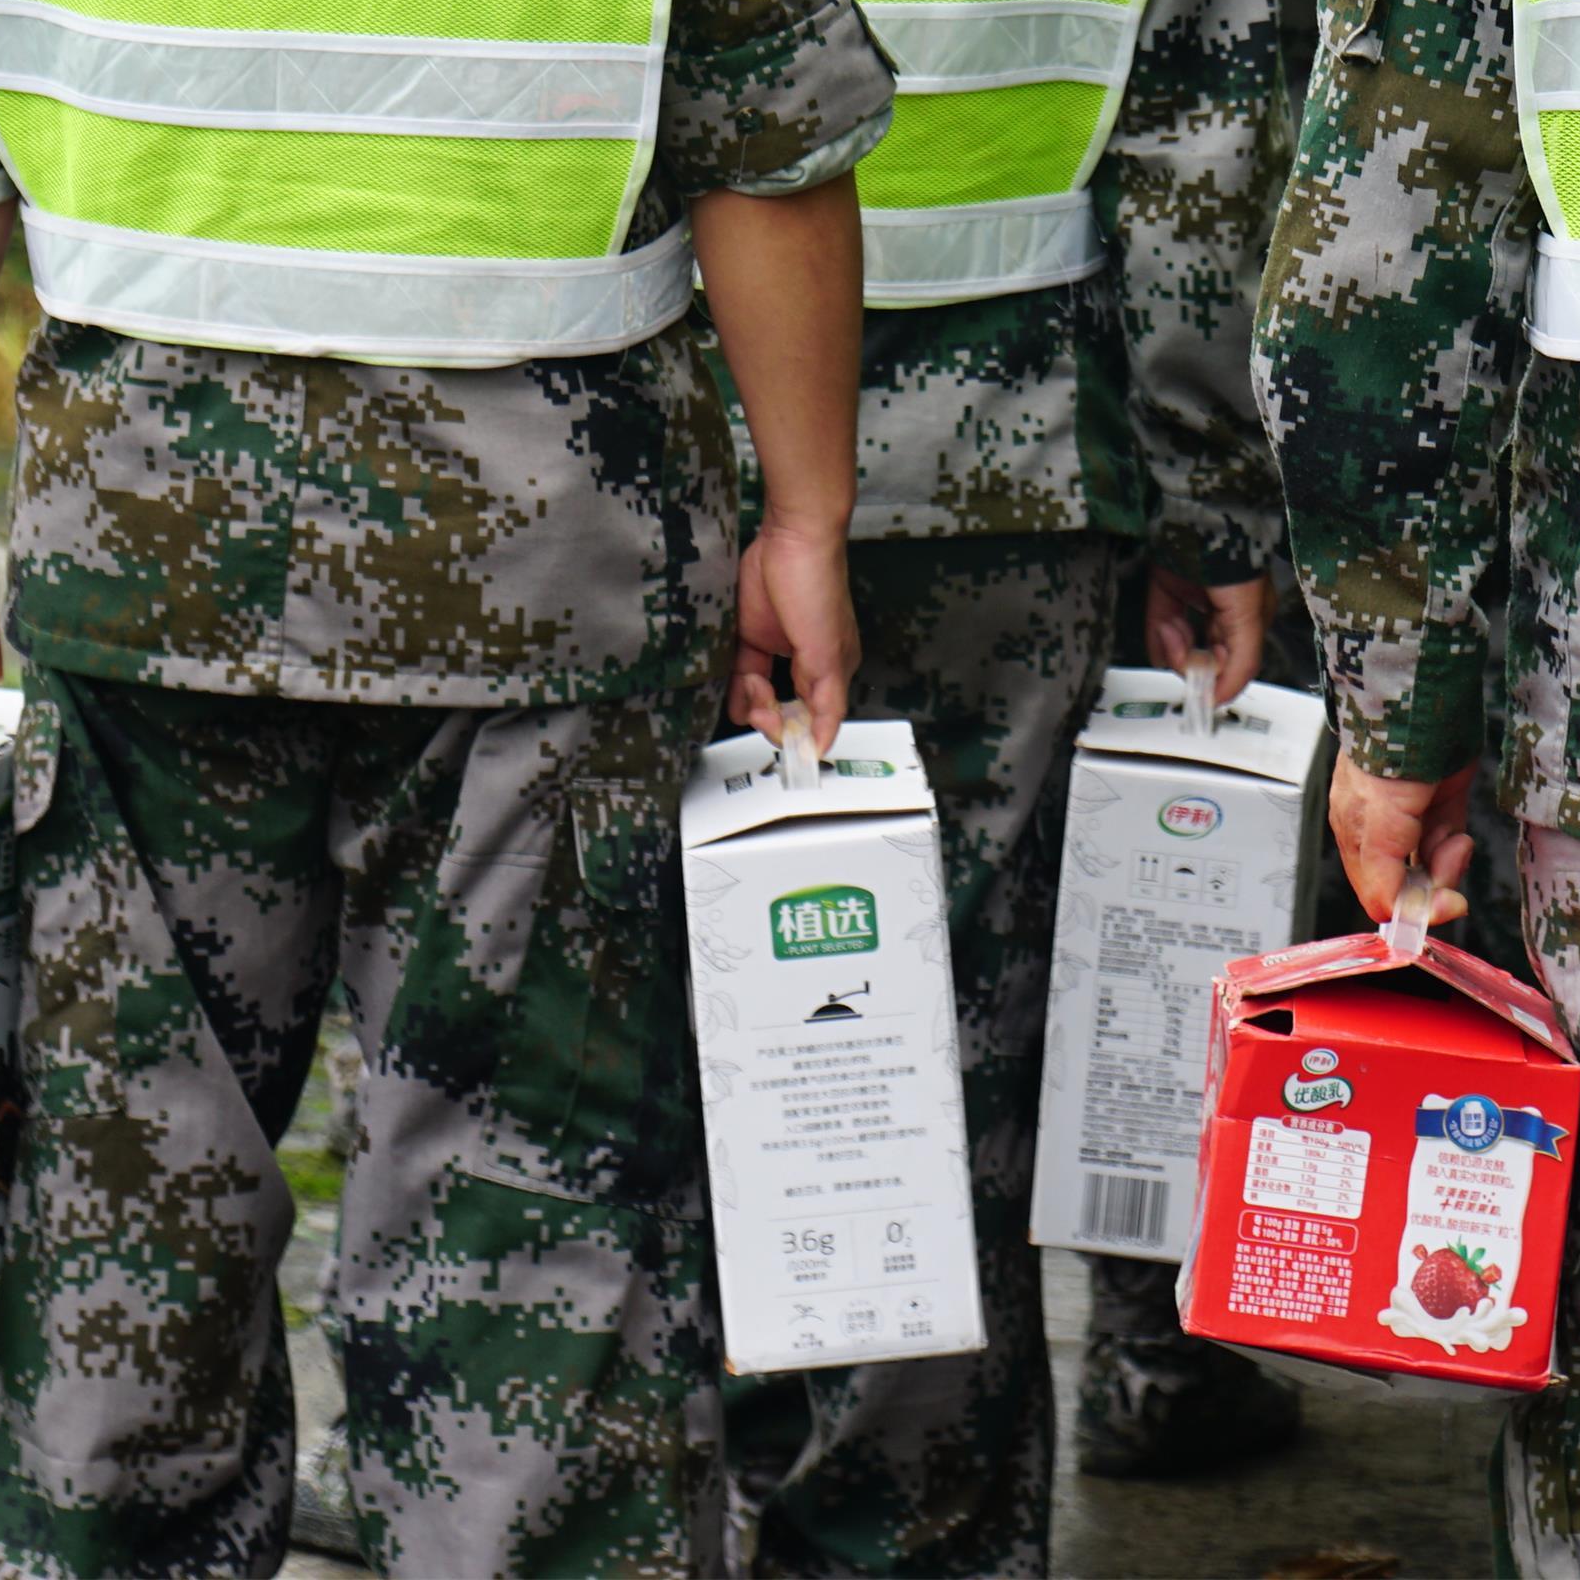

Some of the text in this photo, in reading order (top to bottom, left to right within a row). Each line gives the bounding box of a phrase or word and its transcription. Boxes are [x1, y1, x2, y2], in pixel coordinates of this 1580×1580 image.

[1166, 805, 1215, 828] 伊利
[777, 897, 873, 943] 植选
[1308, 1055, 1332, 1066] 伊利
[1294, 1081, 1344, 1105] 优酸乳
[1290, 1117, 1334, 1133] 营养成分表
[781, 1229, 836, 1256] 3.6g
